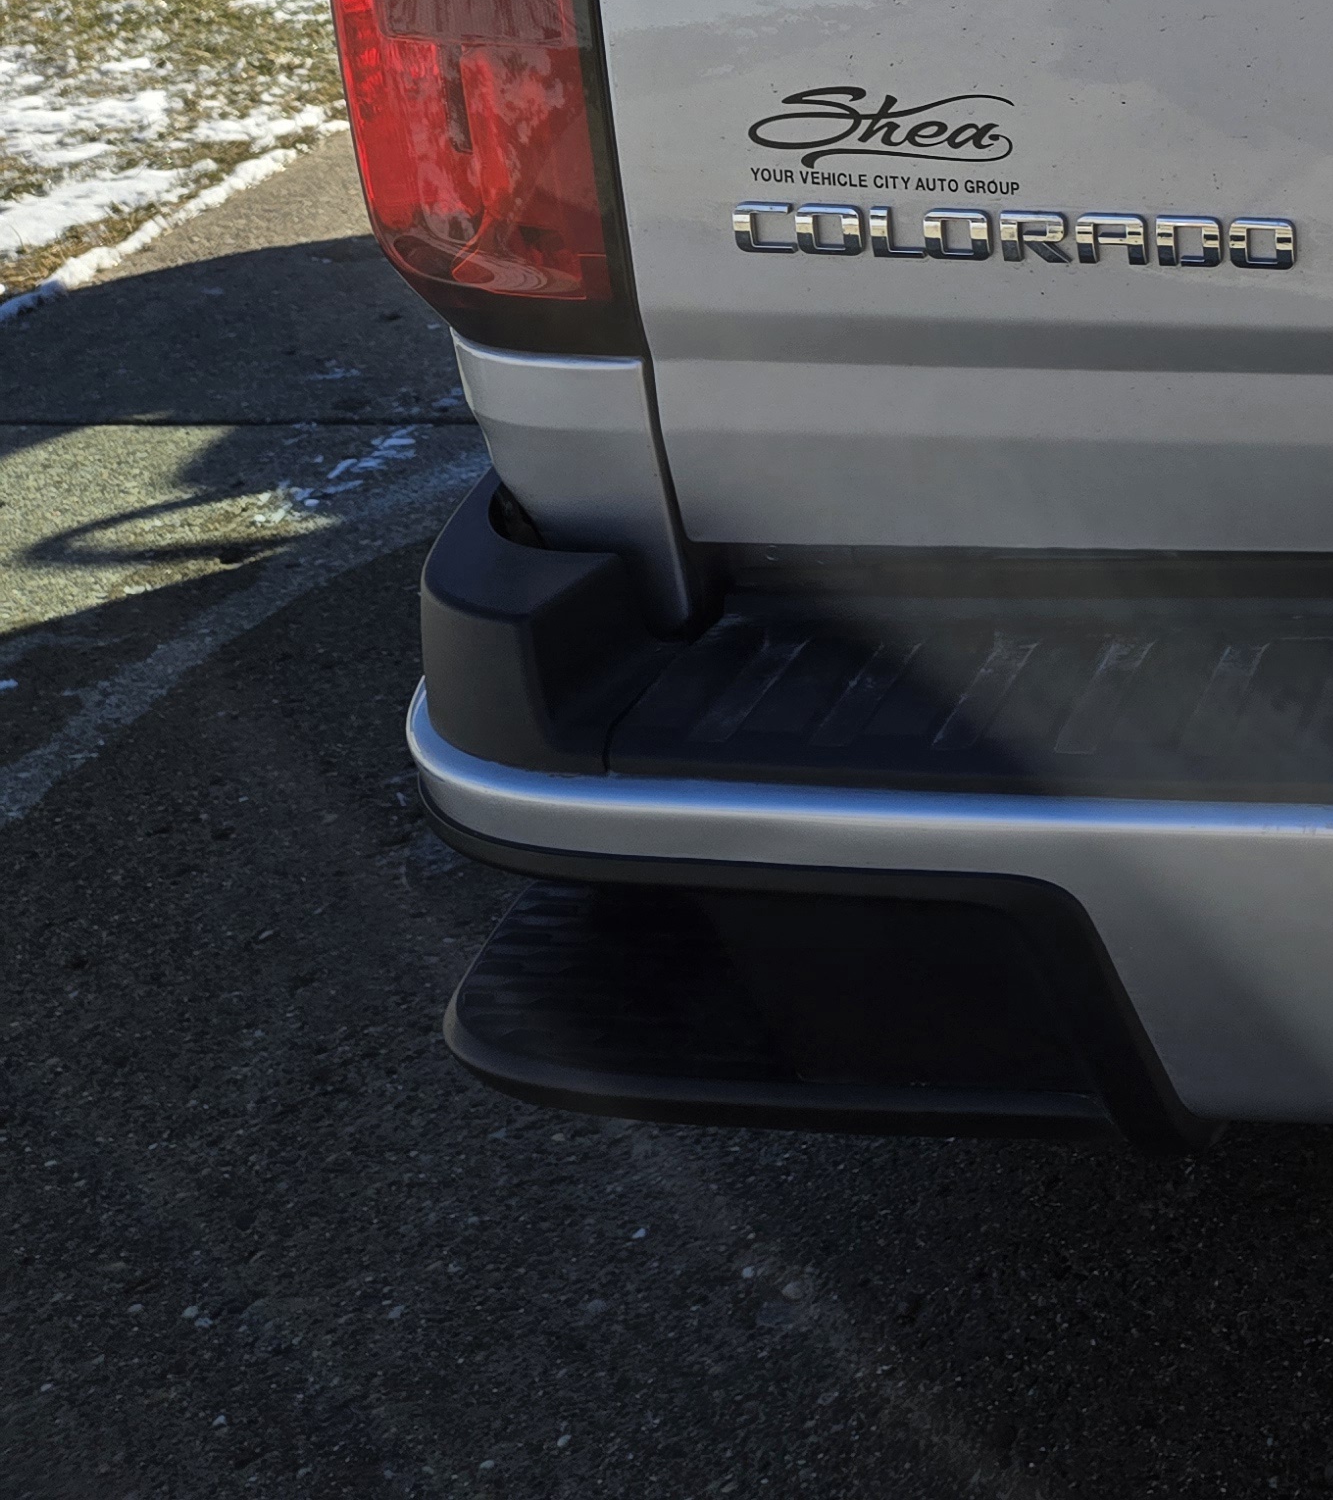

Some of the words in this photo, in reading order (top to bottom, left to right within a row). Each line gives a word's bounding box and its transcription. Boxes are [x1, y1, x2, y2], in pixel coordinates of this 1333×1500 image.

[748, 85, 1015, 168] Shea
[750, 167, 795, 184] YOUR
[800, 170, 868, 189] VEHICLE
[873, 174, 911, 190] CITY
[915, 177, 959, 192] AUTO
[964, 179, 1020, 196] GROUP
[731, 200, 1299, 271] COLORADO
